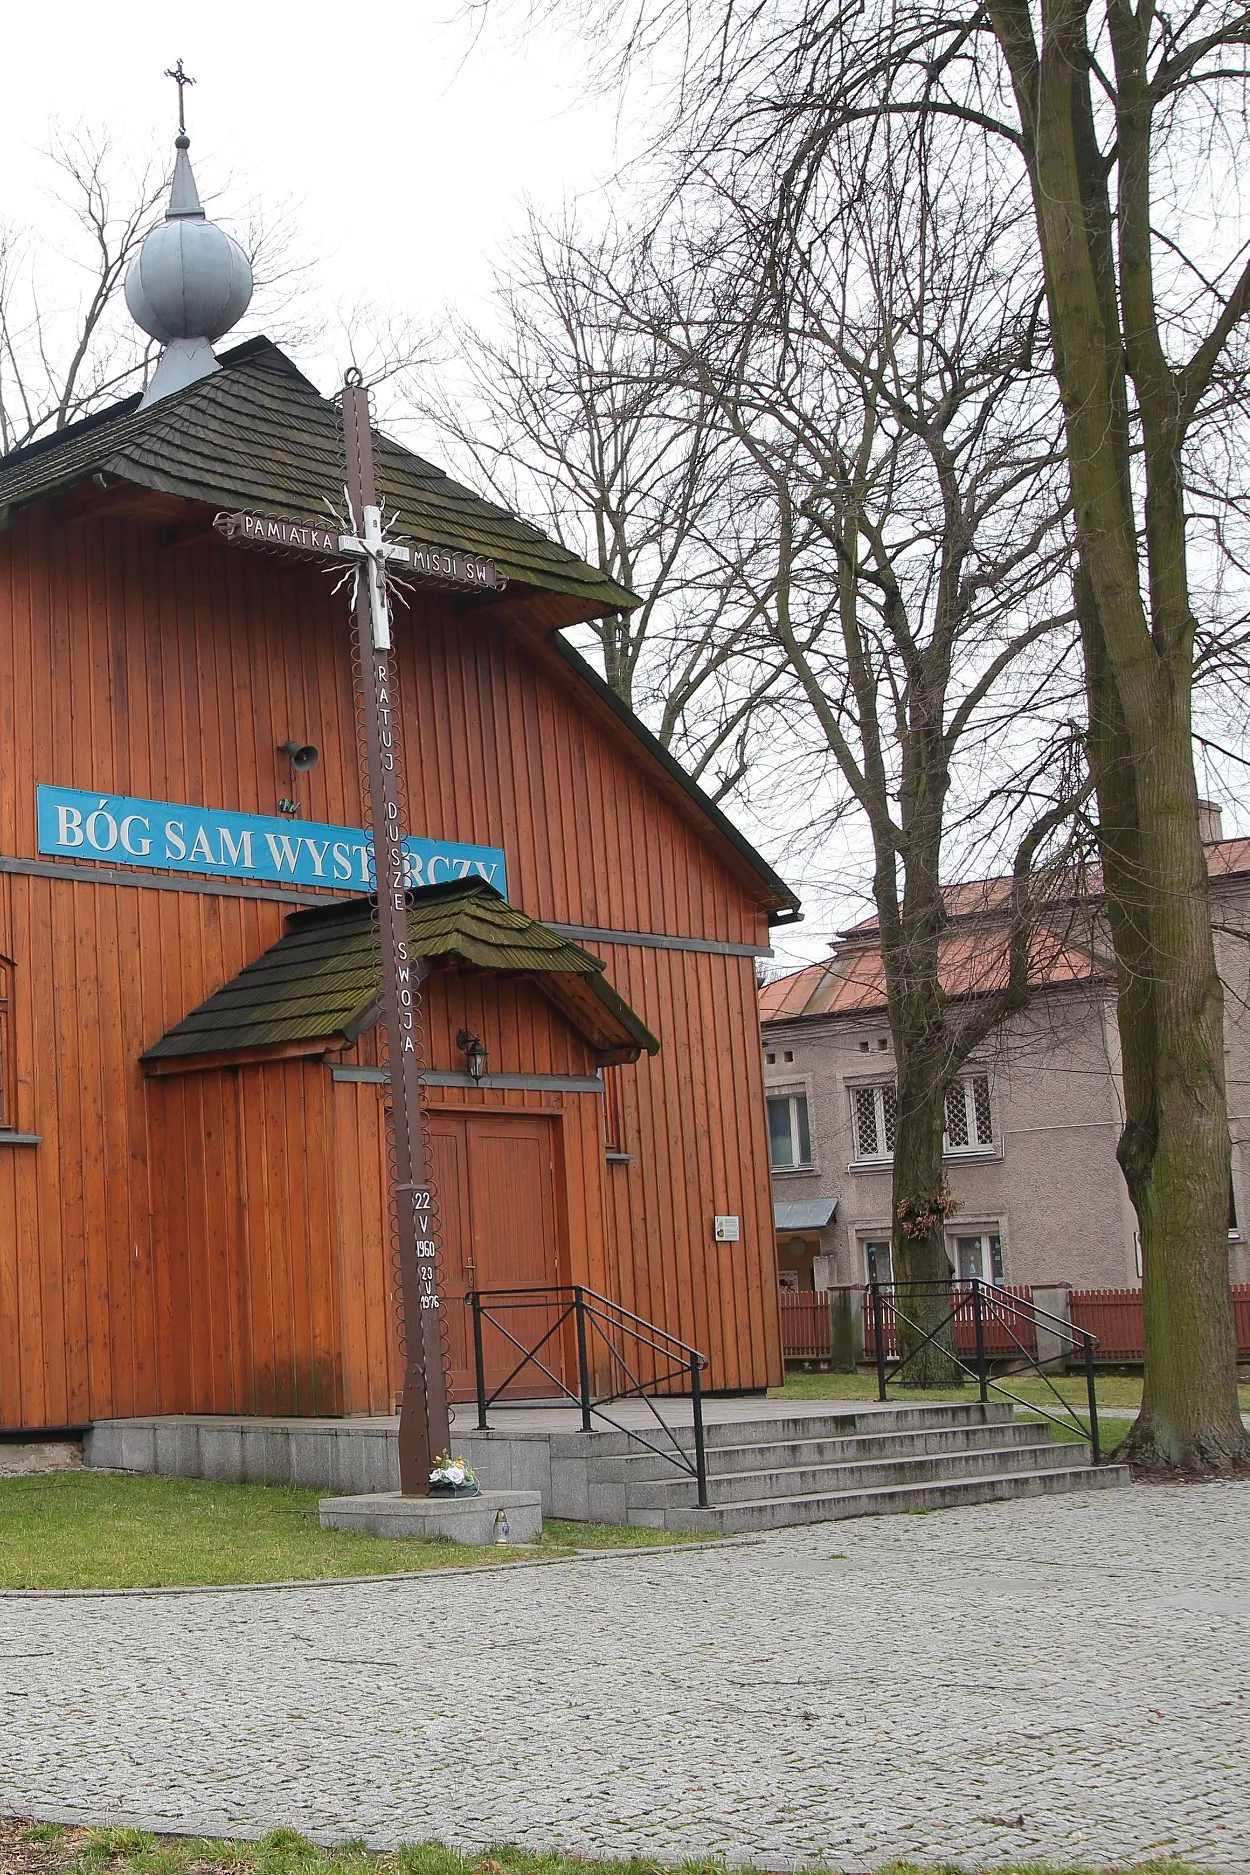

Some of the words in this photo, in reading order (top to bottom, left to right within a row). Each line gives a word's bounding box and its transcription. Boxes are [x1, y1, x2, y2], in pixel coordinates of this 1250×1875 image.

[245, 516, 333, 550] PAMIATKA
[414, 551, 457, 575] MISJI
[54, 799, 154, 857] BÓG
[165, 820, 258, 870] SAM
[263, 833, 499, 888] WYSTRCZY
[378, 665, 394, 771] RATUJ
[388, 802, 404, 911] DUSZE
[398, 942, 415, 1053] SWOJA
[414, 1192, 431, 1210] 22
[419, 1215, 428, 1233] V
[416, 1240, 436, 1258] 1960
[421, 1266, 433, 1281] 23
[425, 1280, 431, 1295] V
[420, 1295, 440, 1309] 1976
